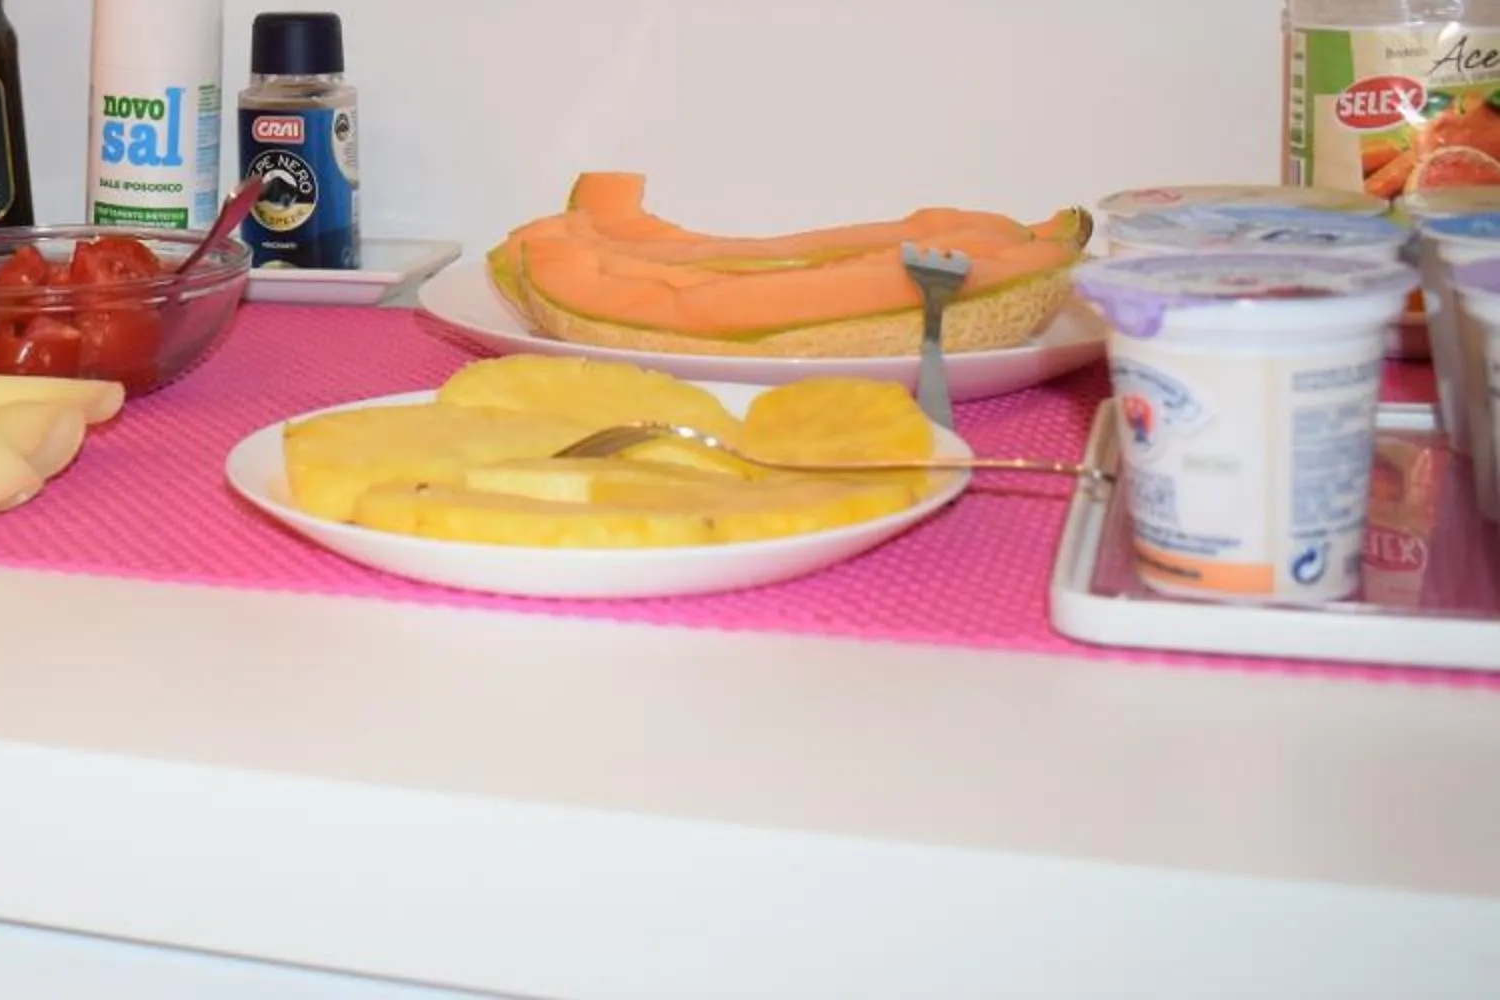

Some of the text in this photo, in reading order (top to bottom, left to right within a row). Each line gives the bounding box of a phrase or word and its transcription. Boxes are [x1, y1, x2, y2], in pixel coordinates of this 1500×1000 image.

[103, 95, 165, 121] novo
[1337, 87, 1419, 118] SELEX
[101, 87, 185, 167] sal
[256, 120, 300, 138] CRAI
[277, 154, 313, 194] NERO
